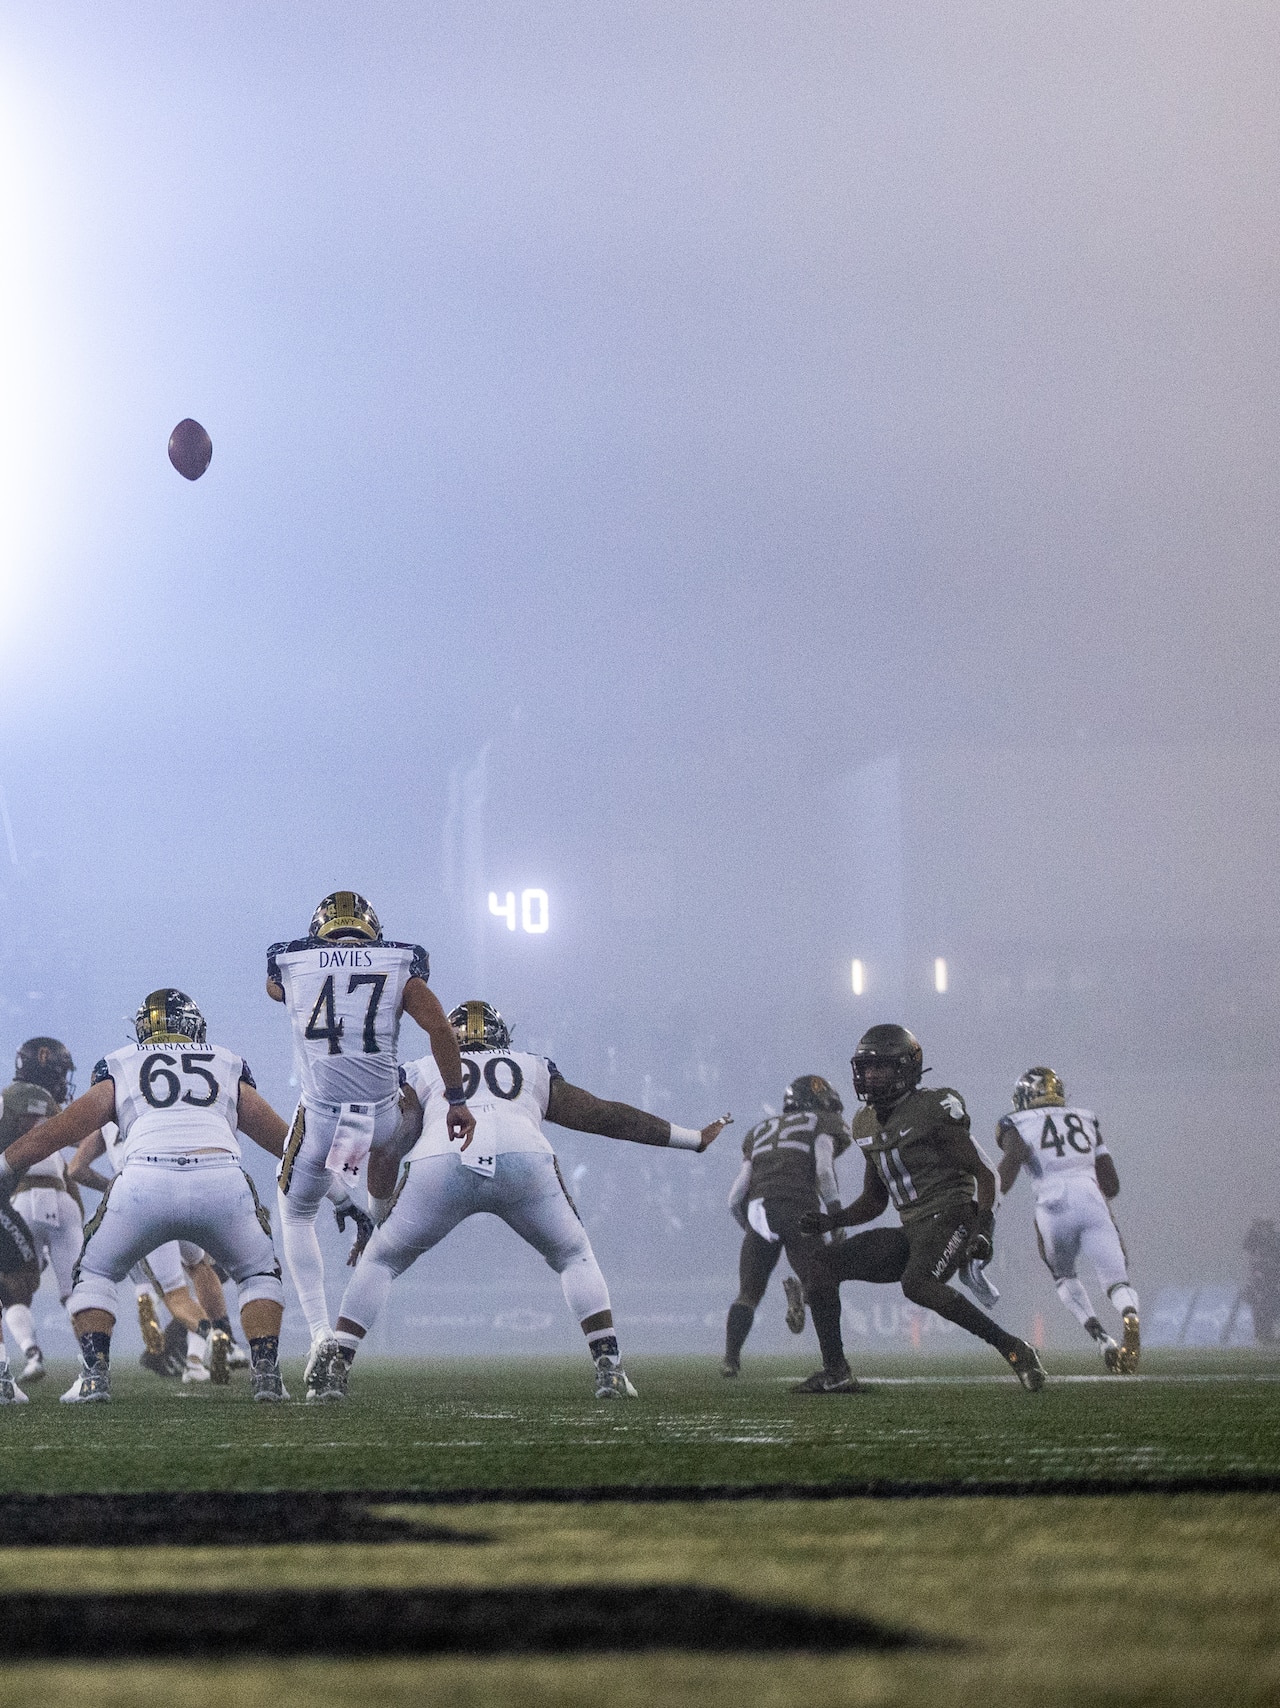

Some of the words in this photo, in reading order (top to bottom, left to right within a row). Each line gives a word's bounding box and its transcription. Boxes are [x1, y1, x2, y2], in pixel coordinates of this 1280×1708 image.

[333, 919, 356, 927] NAVY
[488, 888, 549, 934] 40
[319, 951, 373, 969] DAVIES
[304, 973, 389, 1056] 47
[139, 1053, 220, 1109] 65
[751, 1111, 819, 1159] 22
[1040, 1112, 1092, 1158] 48
[879, 1147, 919, 1206] 11
